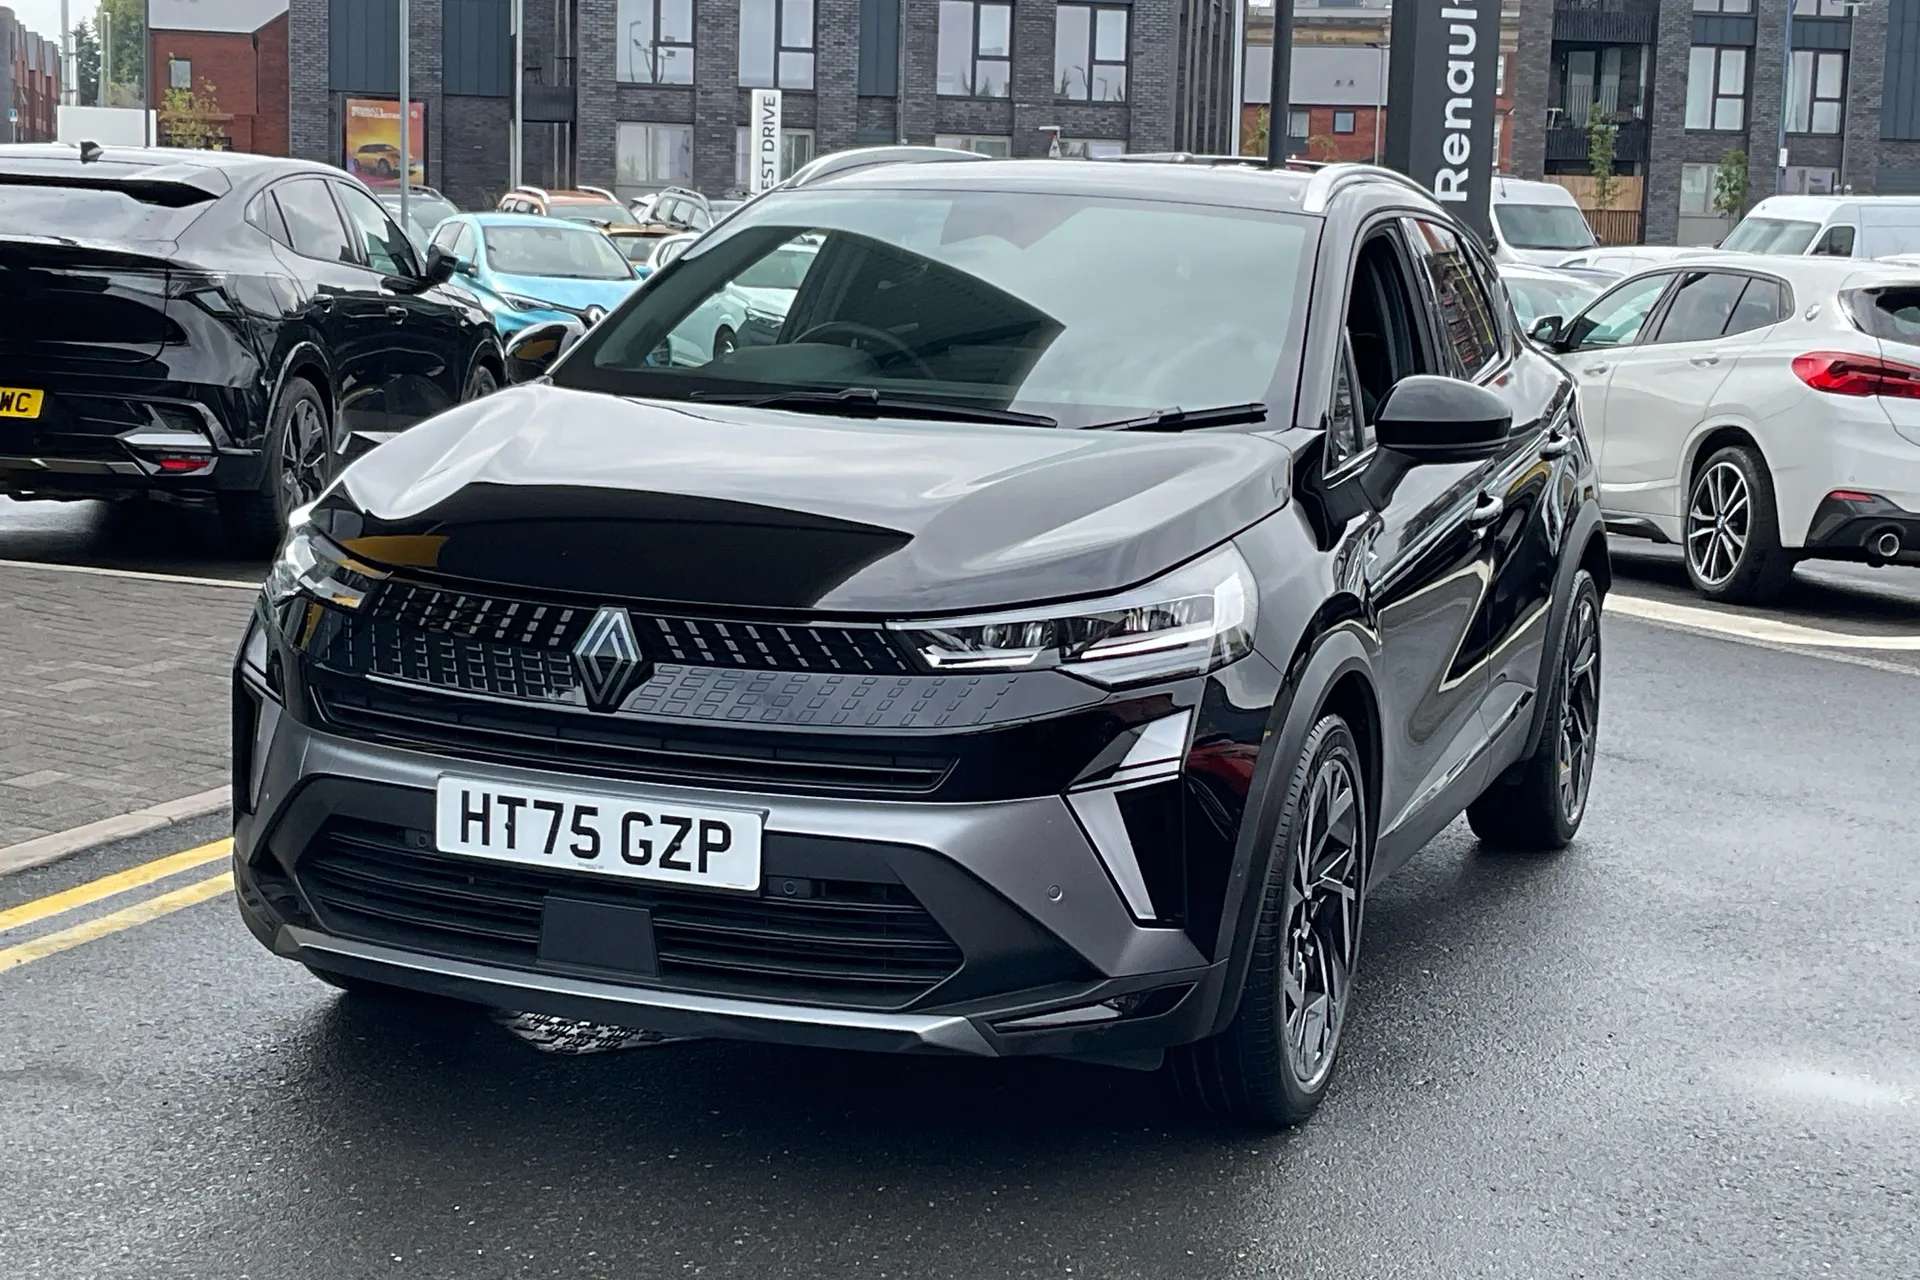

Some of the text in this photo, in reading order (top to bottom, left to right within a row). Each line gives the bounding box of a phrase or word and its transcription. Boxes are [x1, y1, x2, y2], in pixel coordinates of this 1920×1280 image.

[761, 96, 776, 190] EST DRIVE
[1434, 0, 1478, 201] Renaul
[460, 790, 732, 873] HT75 GZP
